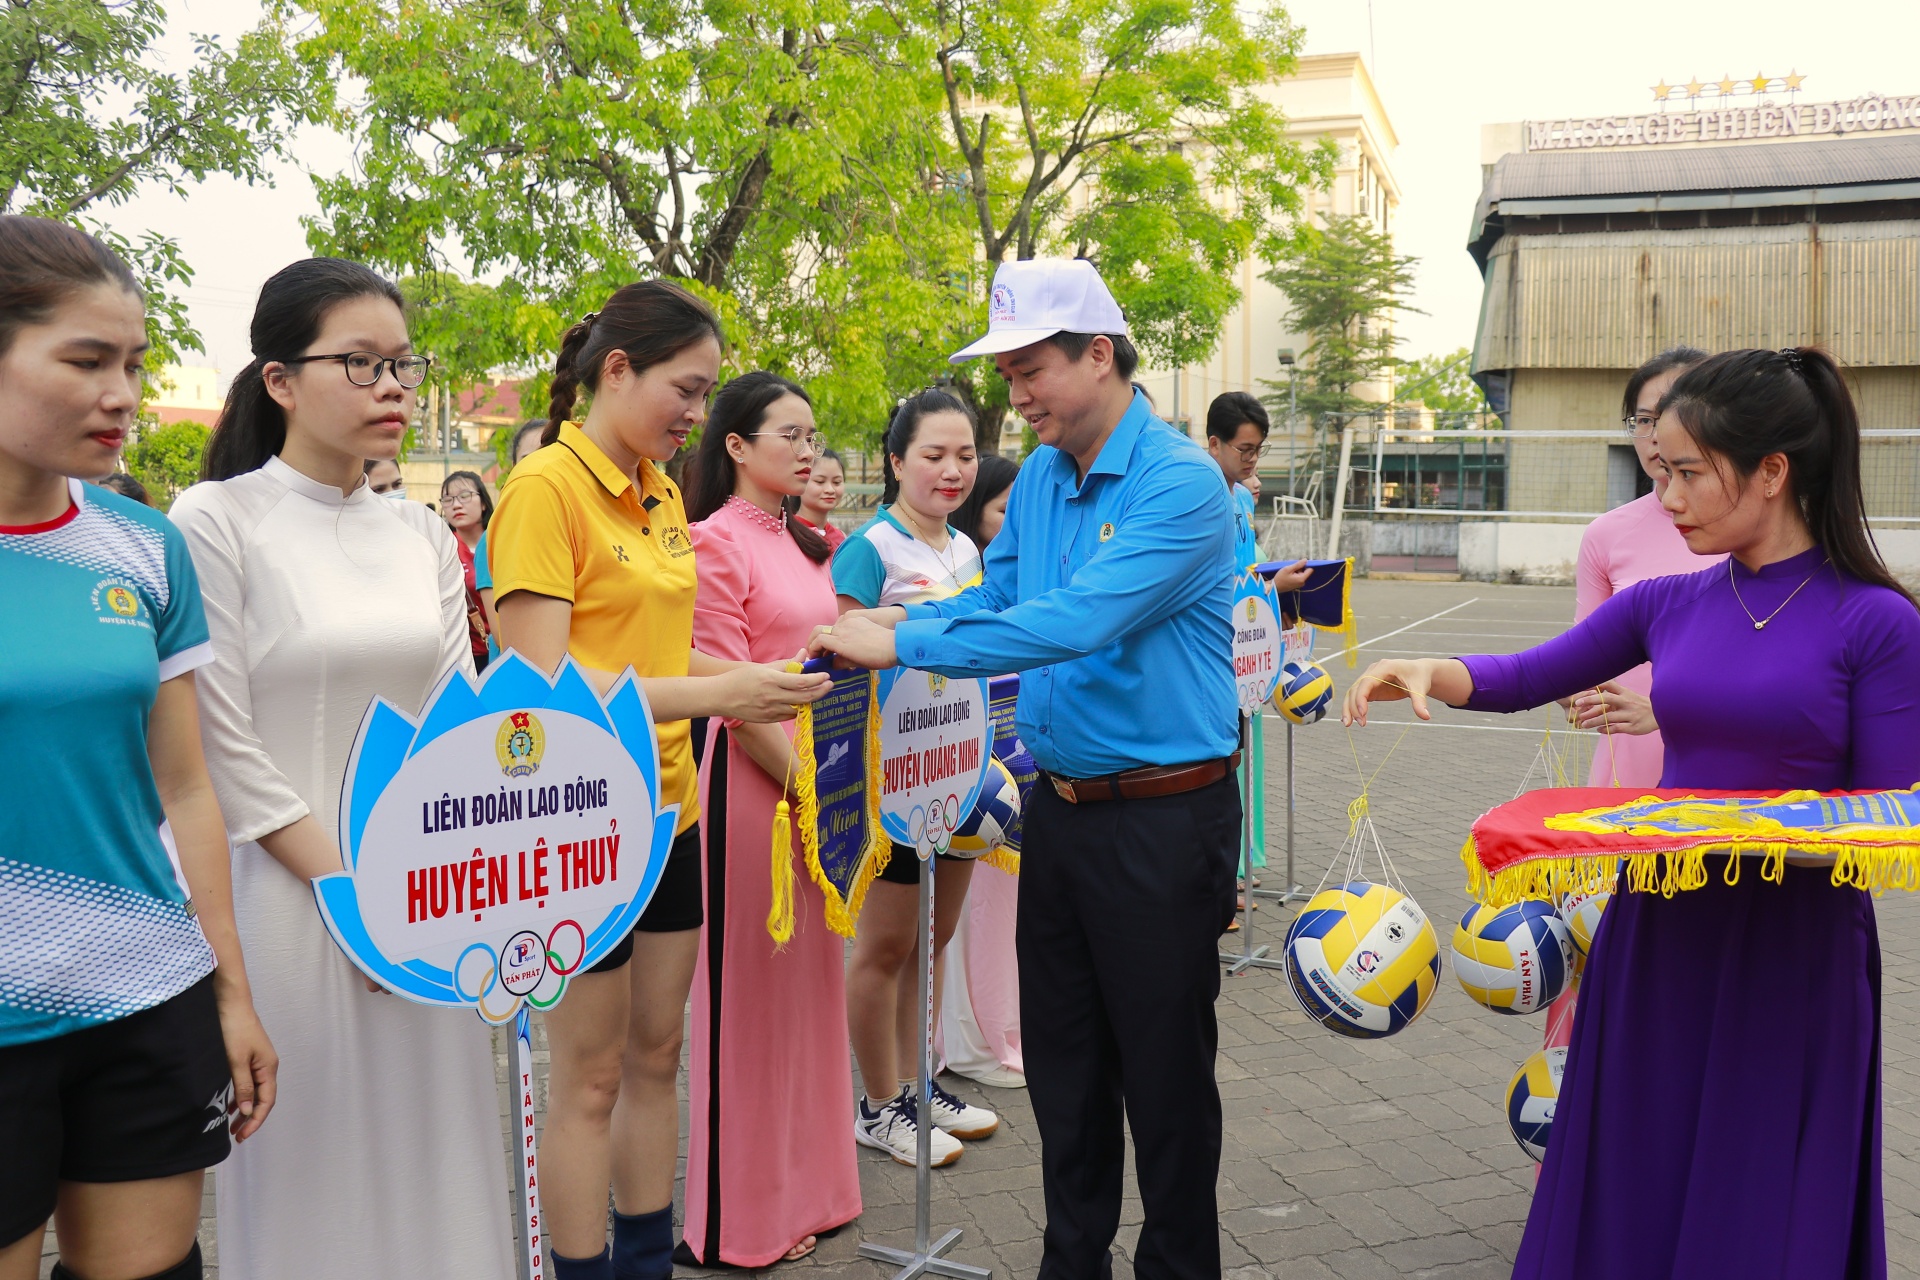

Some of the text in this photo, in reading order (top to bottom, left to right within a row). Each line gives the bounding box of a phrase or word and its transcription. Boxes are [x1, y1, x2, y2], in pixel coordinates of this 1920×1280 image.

[1528, 112, 1688, 151] MASSAGE
[1697, 100, 1803, 142] THIÊN
[1237, 628, 1252, 644] CÔNG
[1258, 652, 1263, 673] Y
[899, 706, 916, 735] LIÊN
[918, 702, 938, 731] ĐOÀN
[939, 703, 951, 726] LAO
[953, 697, 970, 726] ĐỘNG
[884, 746, 921, 797] HUYỆN
[923, 734, 957, 788] QUẢNG
[959, 736, 979, 774] NINH
[423, 775, 608, 834] LIÊN ĐOÀN LAO ĐỘNG
[407, 818, 621, 923] HUYỆN LỆ THUỶ
[505, 967, 541, 985] TẤN PHÁT
[1309, 968, 1363, 1021] WINNER
[1520, 950, 1535, 1006] TẤN PHÁT
[522, 1073, 534, 1128] TẤN
[525, 1135, 536, 1208] PHÁT
